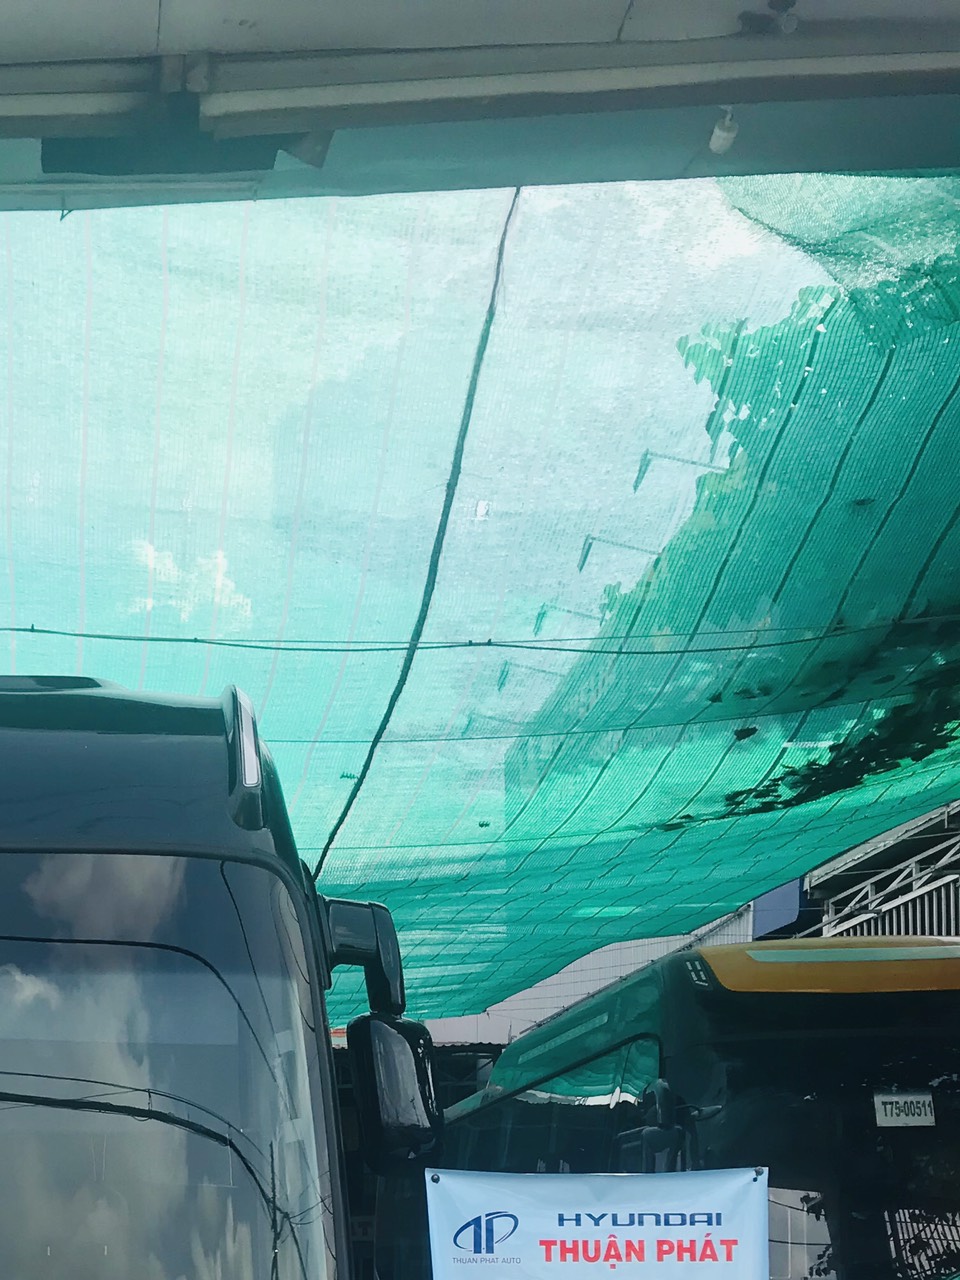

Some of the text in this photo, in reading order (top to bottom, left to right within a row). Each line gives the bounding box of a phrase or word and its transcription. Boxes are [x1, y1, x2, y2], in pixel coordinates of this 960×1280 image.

[881, 1100, 934, 1117] T75-00511
[557, 1212, 722, 1227] HYUNDAI
[539, 1233, 739, 1270] THUẬN PHÁT
